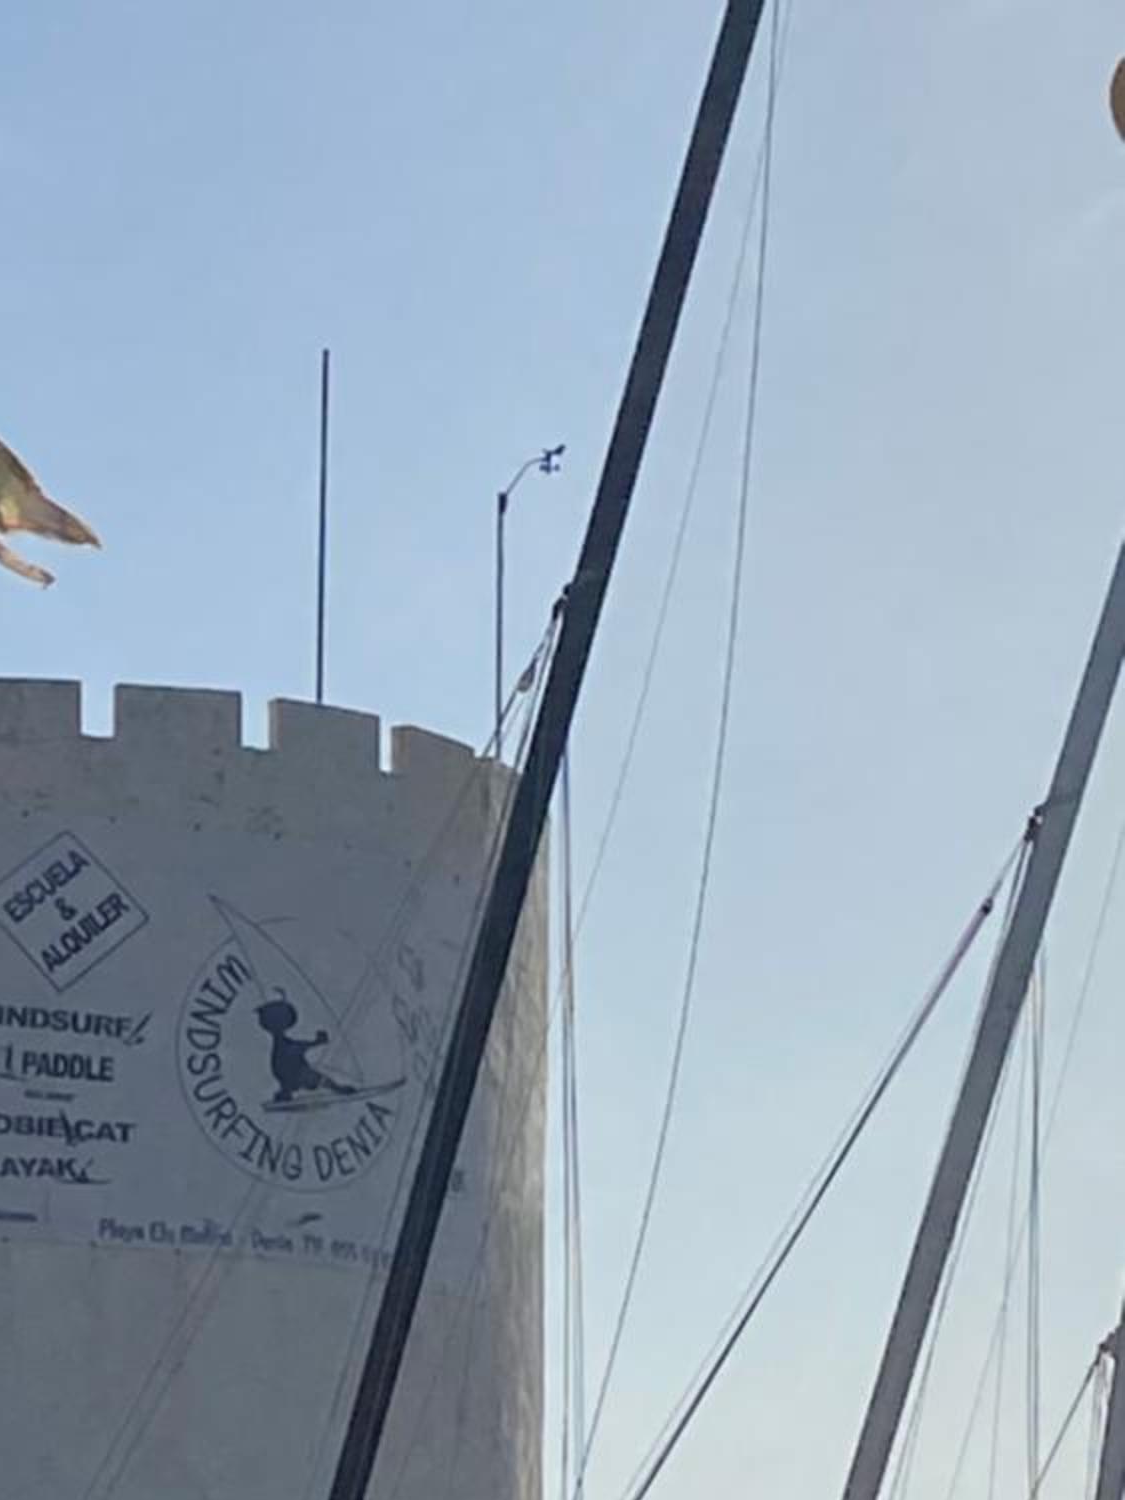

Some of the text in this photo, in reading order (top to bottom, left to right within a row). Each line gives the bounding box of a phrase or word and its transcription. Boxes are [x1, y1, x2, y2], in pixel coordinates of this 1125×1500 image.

[3, 850, 91, 923] ESCUELA
[54, 897, 77, 921] &
[42, 893, 130, 972] ALQUILER
[21, 1050, 114, 1082] PADDLE
[186, 954, 393, 1182] WINDSURFING DENIA
[73, 1117, 136, 1144] CAT
